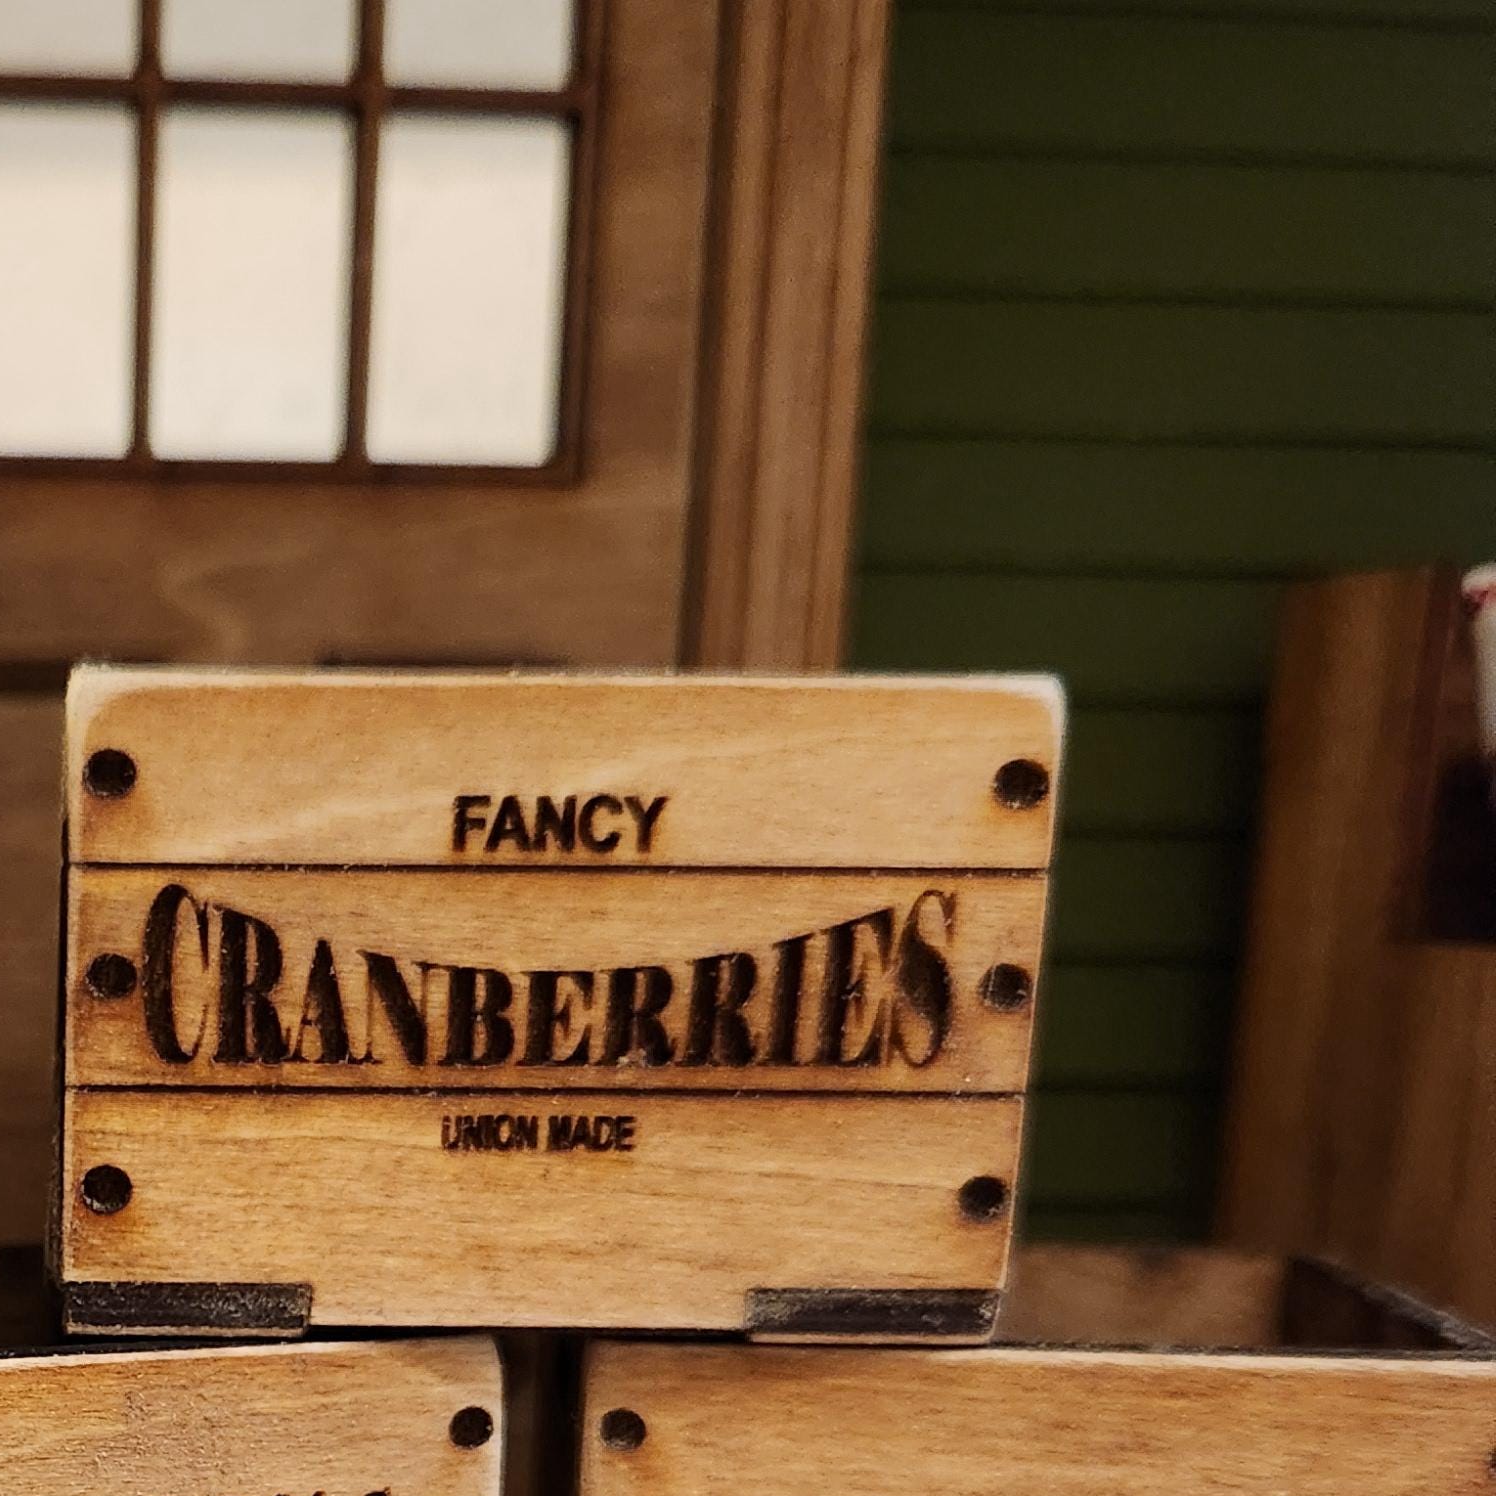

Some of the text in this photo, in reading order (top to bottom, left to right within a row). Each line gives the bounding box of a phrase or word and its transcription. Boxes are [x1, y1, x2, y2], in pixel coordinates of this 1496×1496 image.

[452, 795, 669, 854] FANCY
[142, 882, 959, 1069] CRANBERRIES
[441, 1115, 638, 1152] UNION MADE
